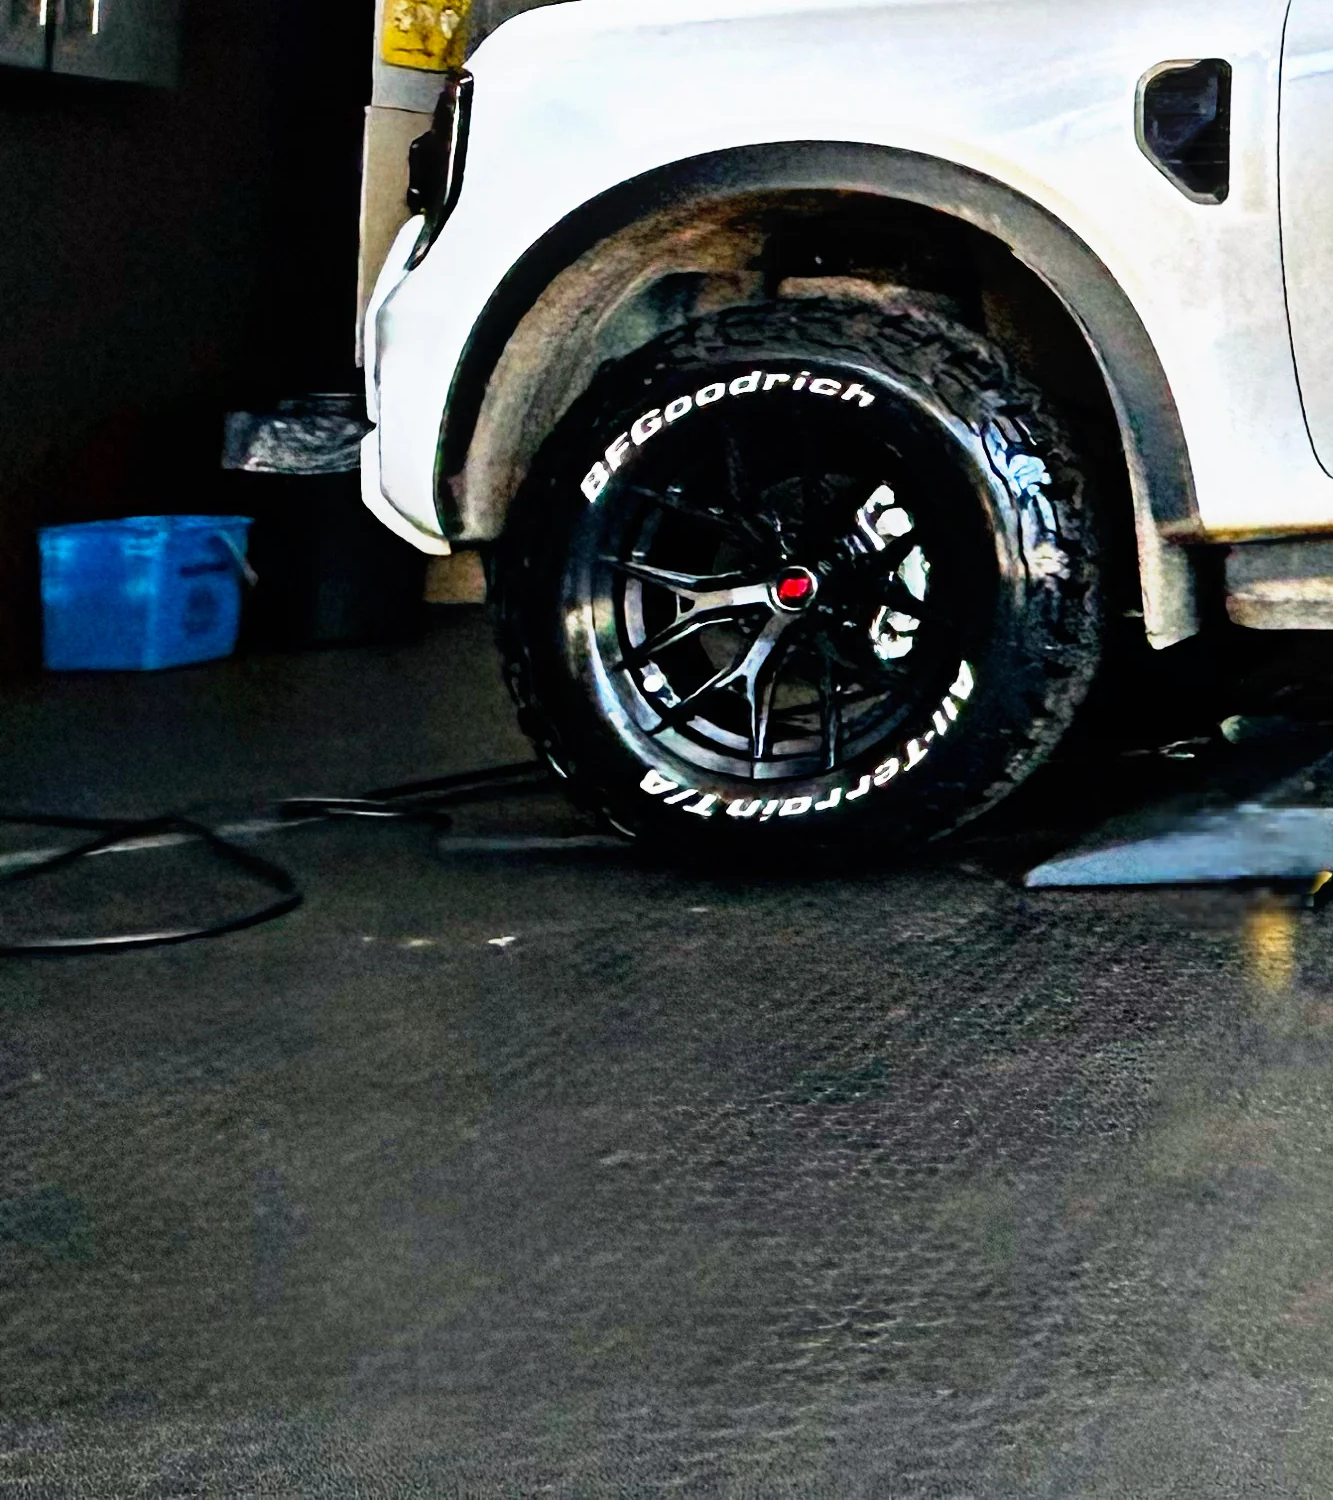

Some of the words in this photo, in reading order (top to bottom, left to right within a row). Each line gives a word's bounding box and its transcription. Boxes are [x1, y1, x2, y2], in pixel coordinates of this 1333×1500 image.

[580, 370, 876, 504] BFGoodrich
[639, 768, 715, 817] T/A
[725, 659, 975, 822] All-Terrain
